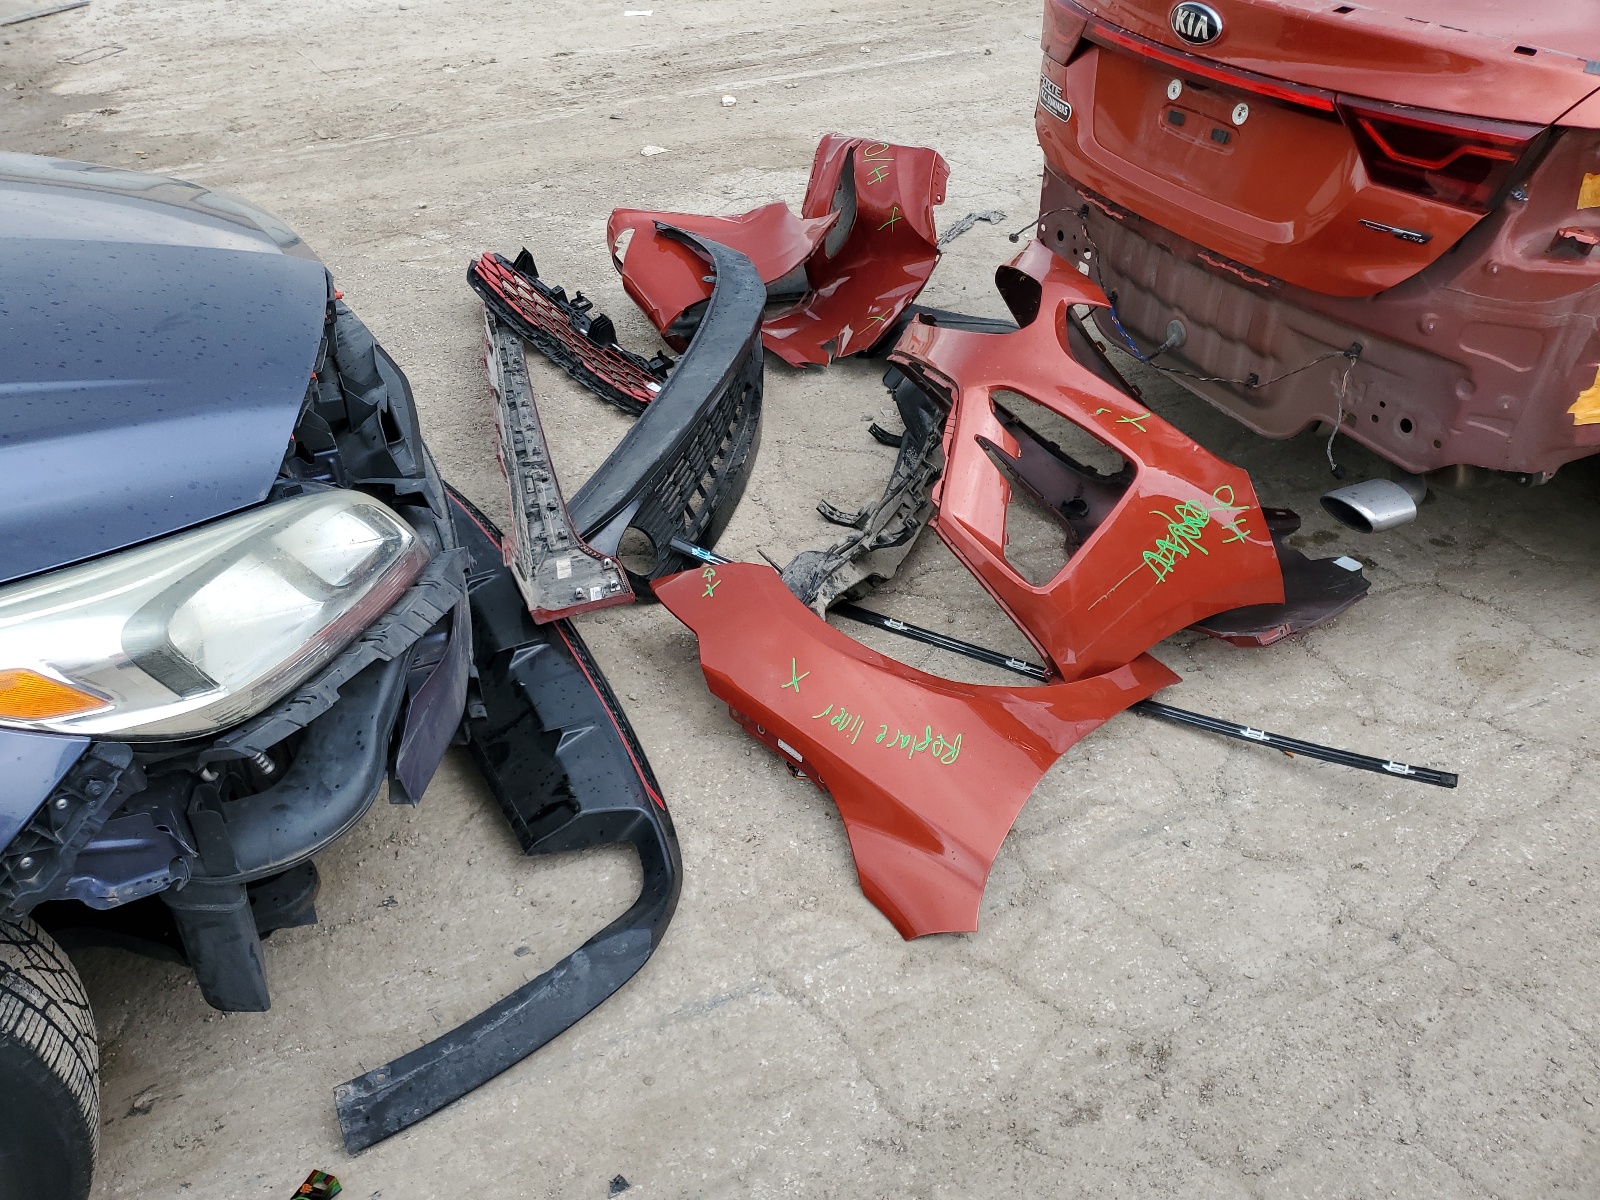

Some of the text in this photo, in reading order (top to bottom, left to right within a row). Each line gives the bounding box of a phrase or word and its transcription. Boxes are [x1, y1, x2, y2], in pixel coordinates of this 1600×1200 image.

[1175, 8, 1209, 40] KIA
[811, 703, 963, 765] Replace liner
